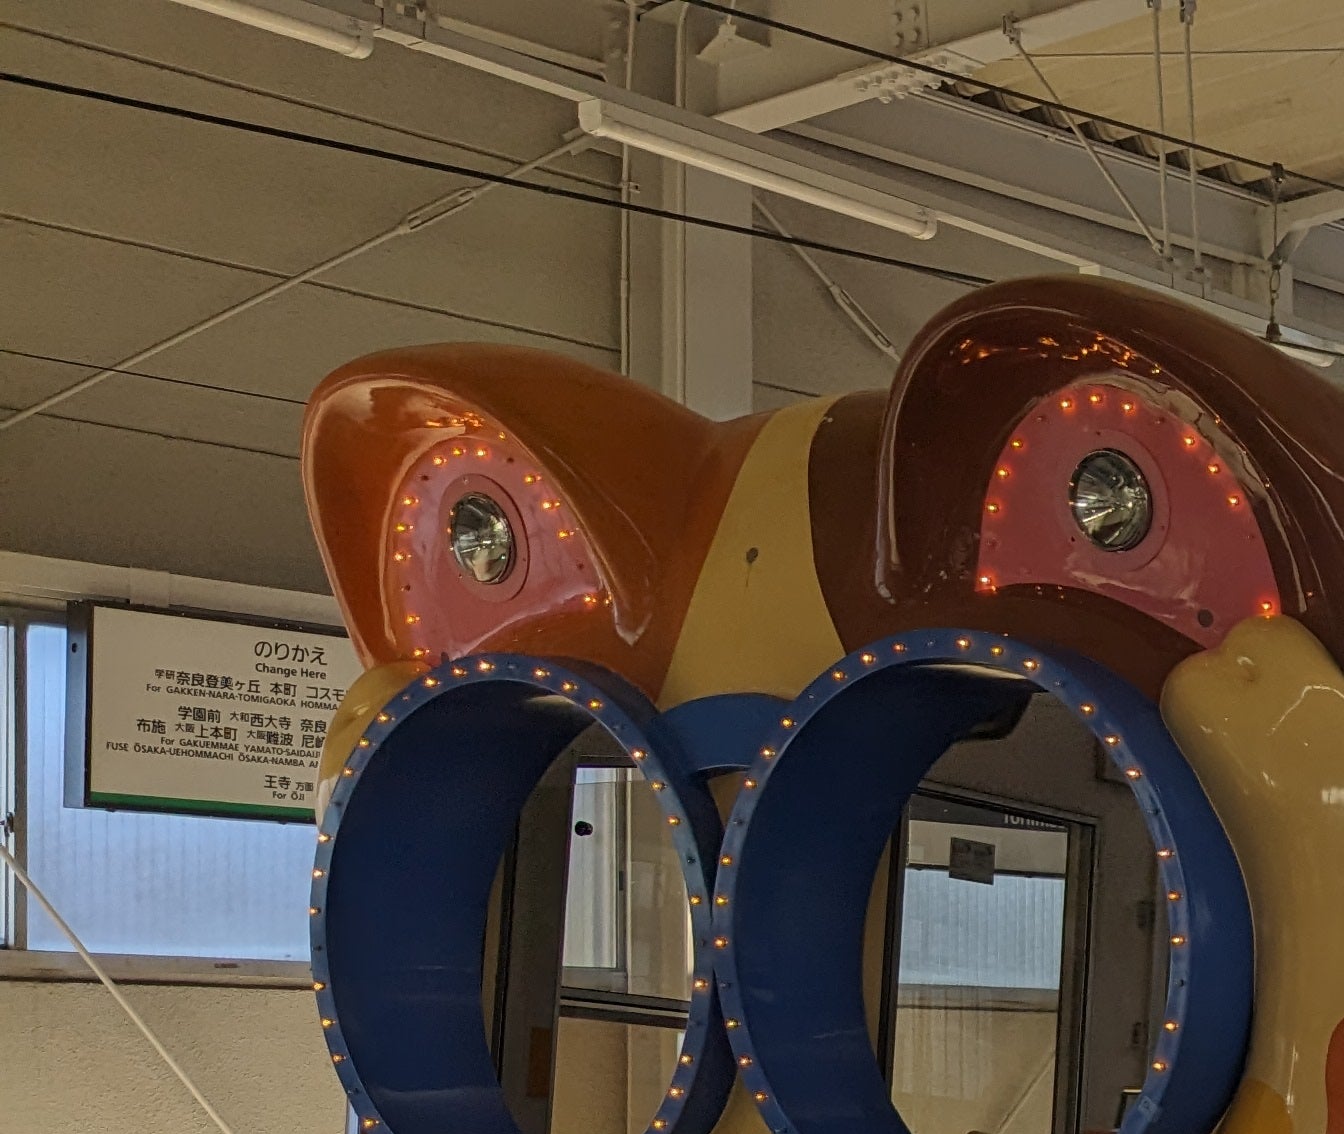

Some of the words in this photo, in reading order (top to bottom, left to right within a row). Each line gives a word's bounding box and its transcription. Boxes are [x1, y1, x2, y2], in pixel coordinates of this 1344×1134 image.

[254, 641, 328, 666] のりかえ
[255, 663, 298, 678] Change
[300, 668, 327, 680] Here
[146, 684, 161, 693] For
[166, 686, 297, 707] GAKKEN-NARA-TOMIGAOKA
[269, 682, 297, 698] 本町
[306, 686, 350, 702] コスモ
[178, 706, 221, 724] 学園前
[230, 711, 292, 731] 大和西大寺
[300, 719, 327, 734] 奈良
[136, 718, 166, 735] 布施
[175, 723, 238, 742] 大阪上本町
[106, 741, 129, 752] FUSE
[160, 737, 175, 746] For
[179, 739, 239, 752] GAKUEMMAE
[264, 774, 291, 790] 王寺
[272, 791, 287, 800] For
